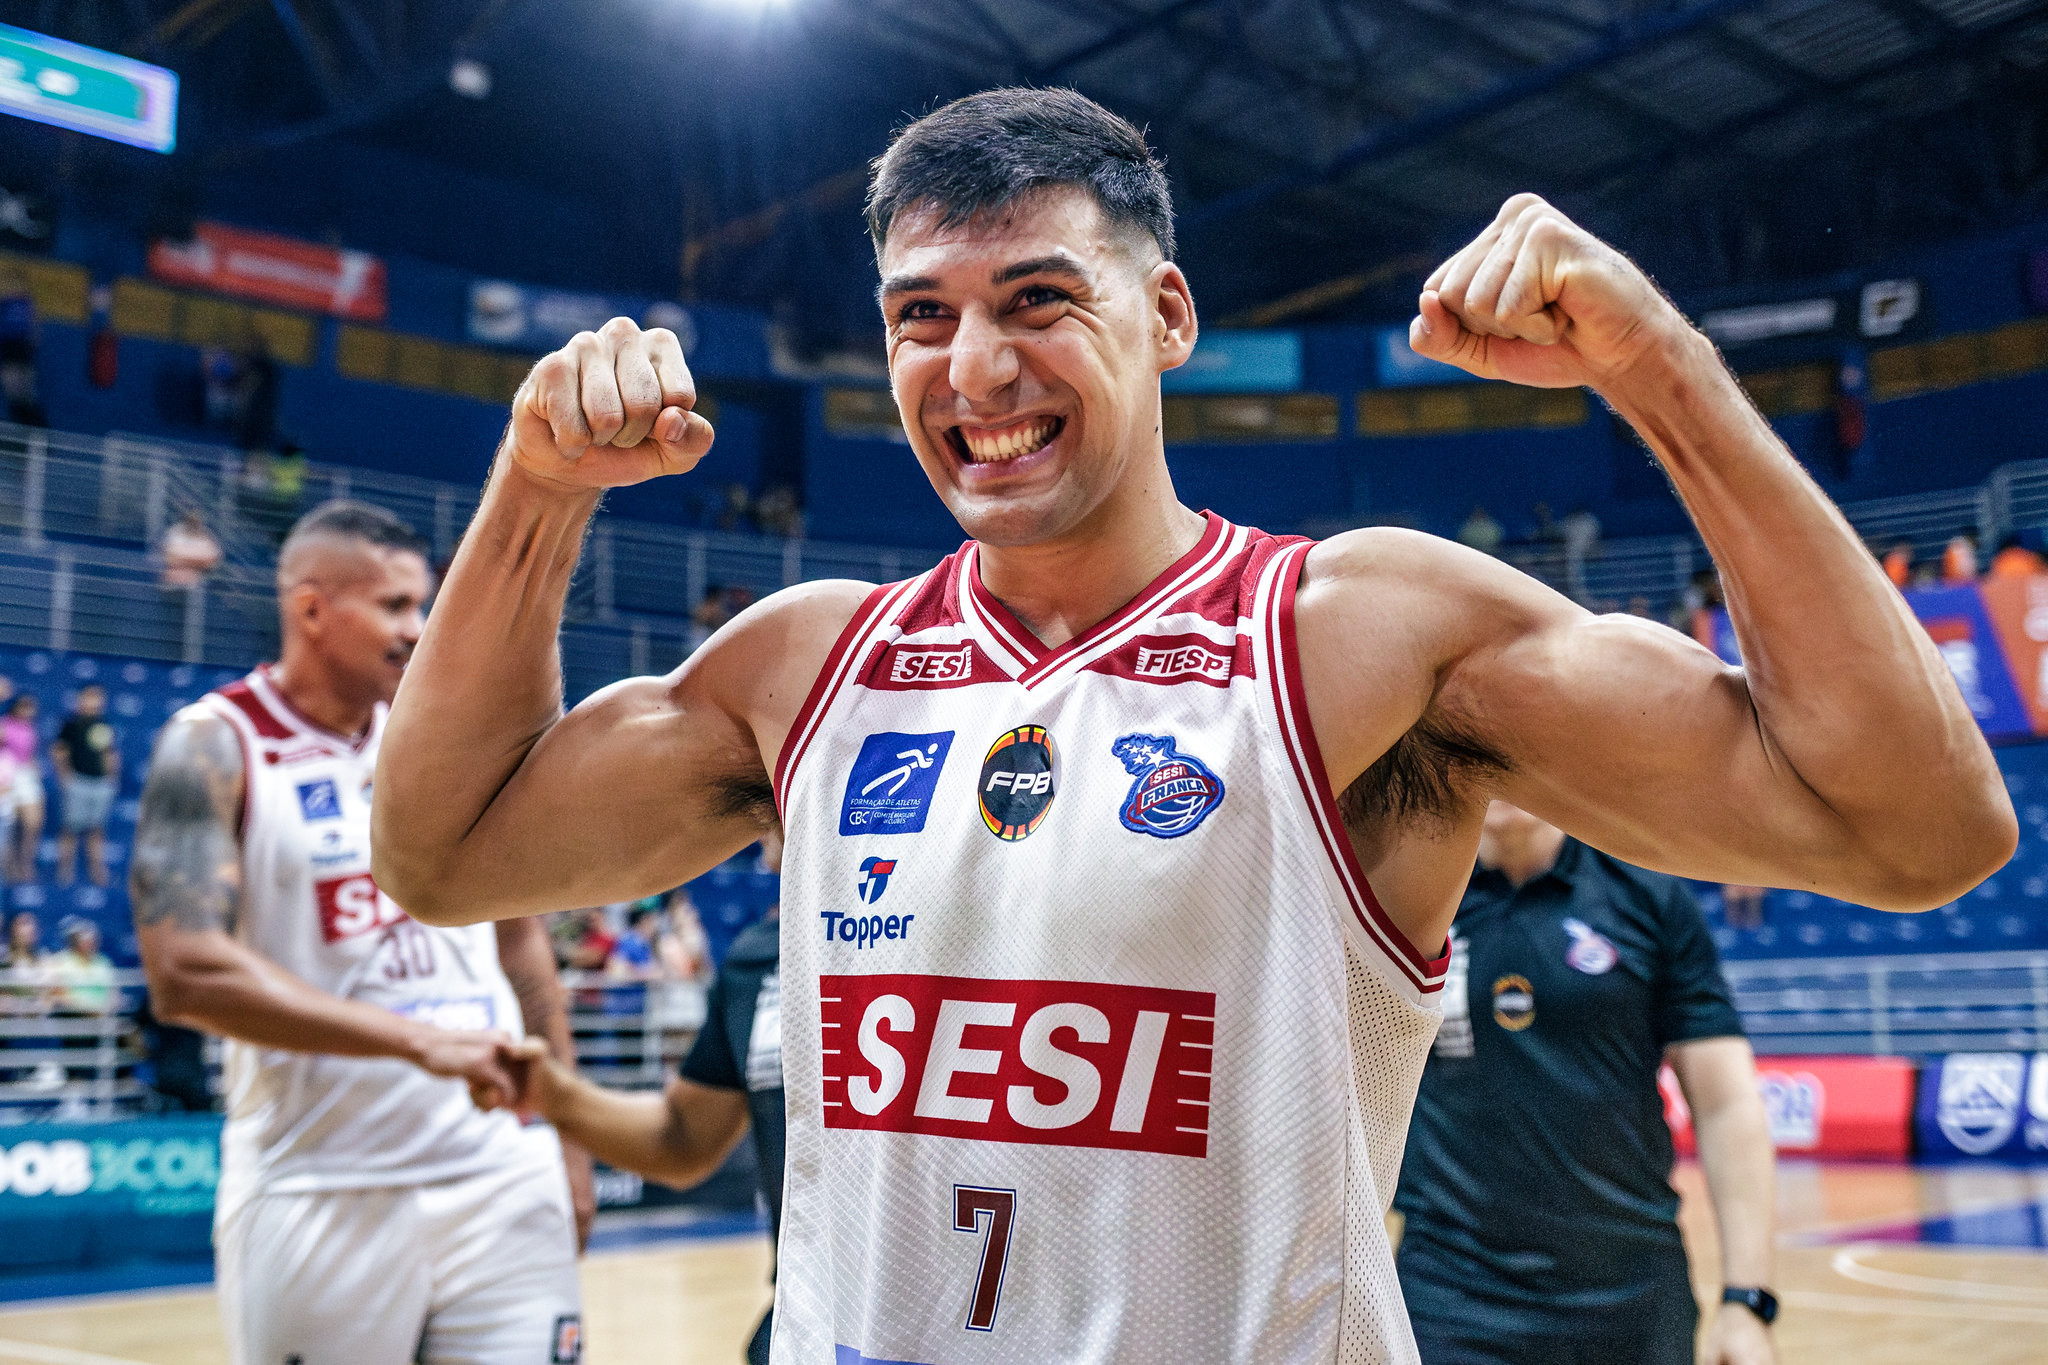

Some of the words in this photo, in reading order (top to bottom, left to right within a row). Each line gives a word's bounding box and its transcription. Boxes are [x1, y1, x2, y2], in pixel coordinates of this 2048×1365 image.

[900, 652, 967, 679] SESI
[1143, 649, 1223, 673] FIESP
[986, 771, 1050, 795] FPB
[1153, 766, 1183, 784] SESI
[885, 798, 895, 806] DE
[895, 798, 921, 806] ATLETAS
[1142, 779, 1205, 809] FRANCA
[849, 811, 870, 825] CBC
[820, 911, 915, 949] Topper
[848, 994, 1170, 1133] SESI
[953, 1183, 1017, 1332] 7
